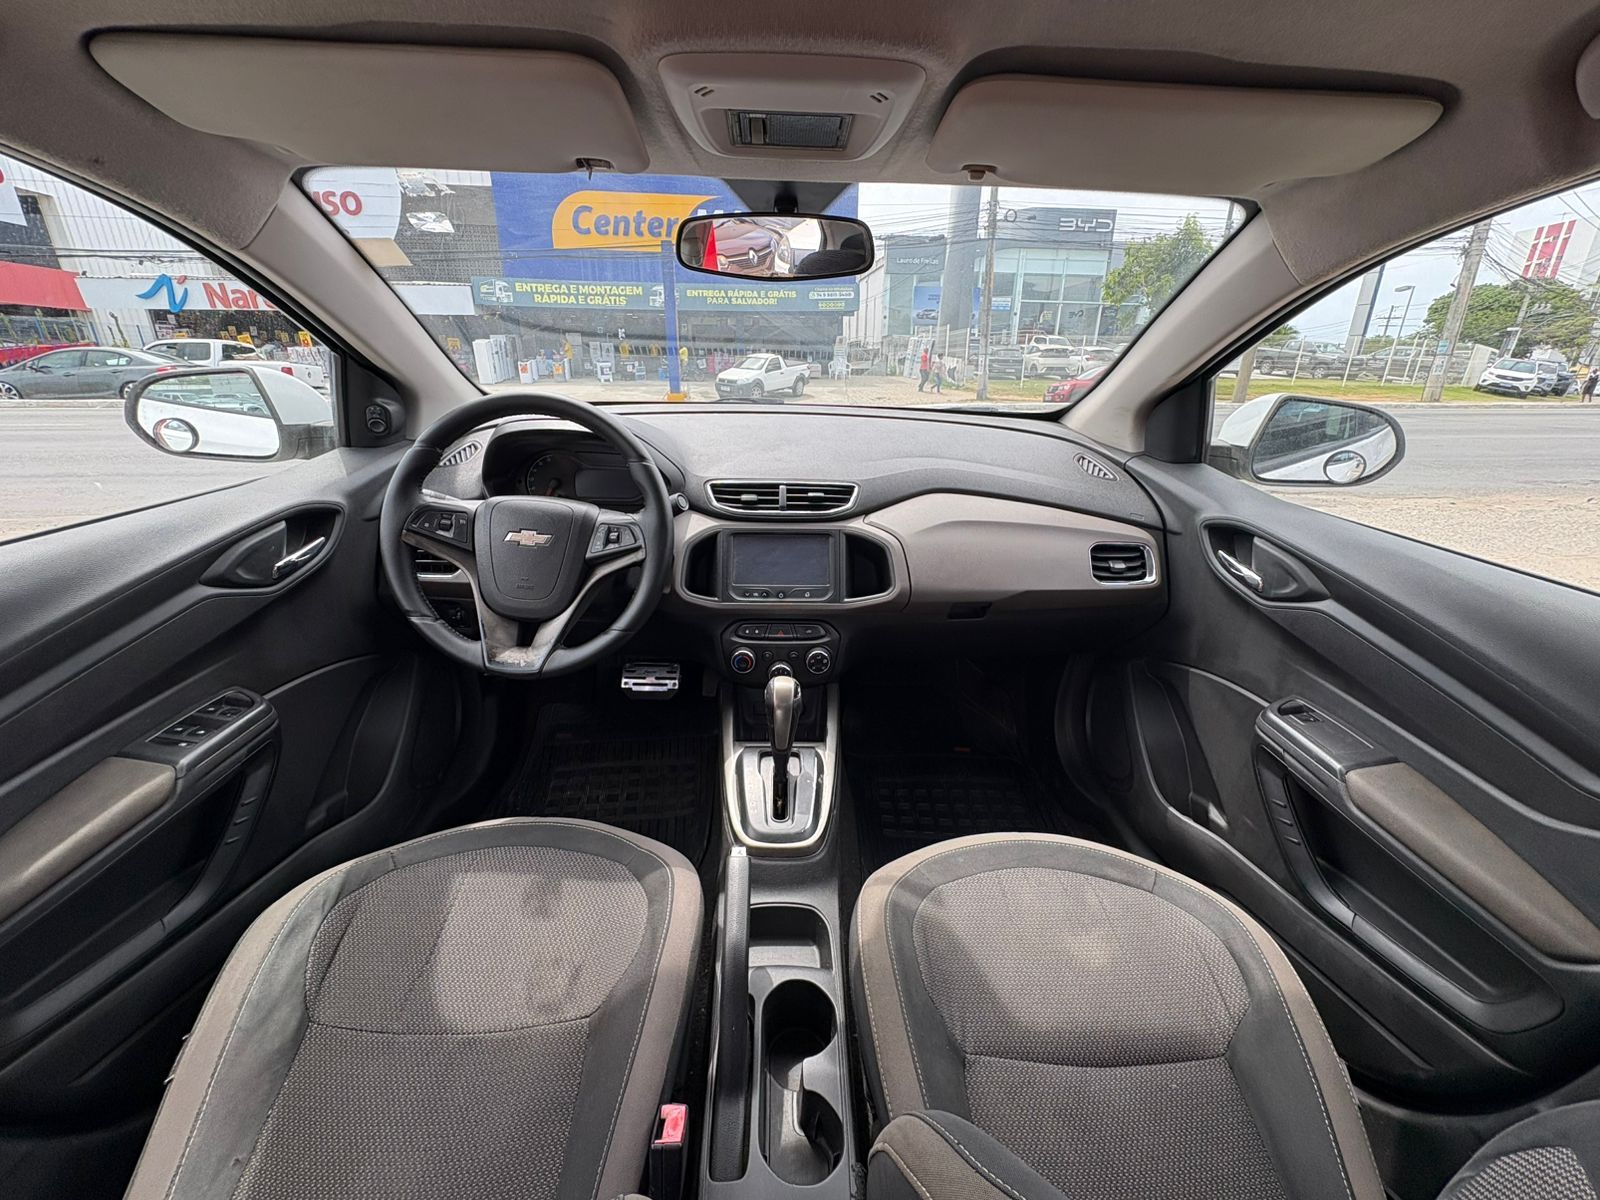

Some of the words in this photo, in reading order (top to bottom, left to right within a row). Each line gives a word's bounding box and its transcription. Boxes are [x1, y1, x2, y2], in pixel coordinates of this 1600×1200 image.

[572, 205, 680, 238] Center
[1059, 217, 1113, 232] BYD
[515, 282, 568, 294] ENTREGA
[570, 285, 577, 294] E
[578, 285, 643, 296] MONTAGEM
[686, 289, 725, 298] ENTREGA
[727, 288, 758, 298] RÁPIDA
[767, 289, 797, 298] GRÁTIS
[534, 293, 577, 304] RÁPIDA
[578, 296, 585, 304] E
[587, 294, 627, 305] GRÁTIS
[707, 297, 730, 305] PARA
[731, 297, 778, 305] SALVADOR!
